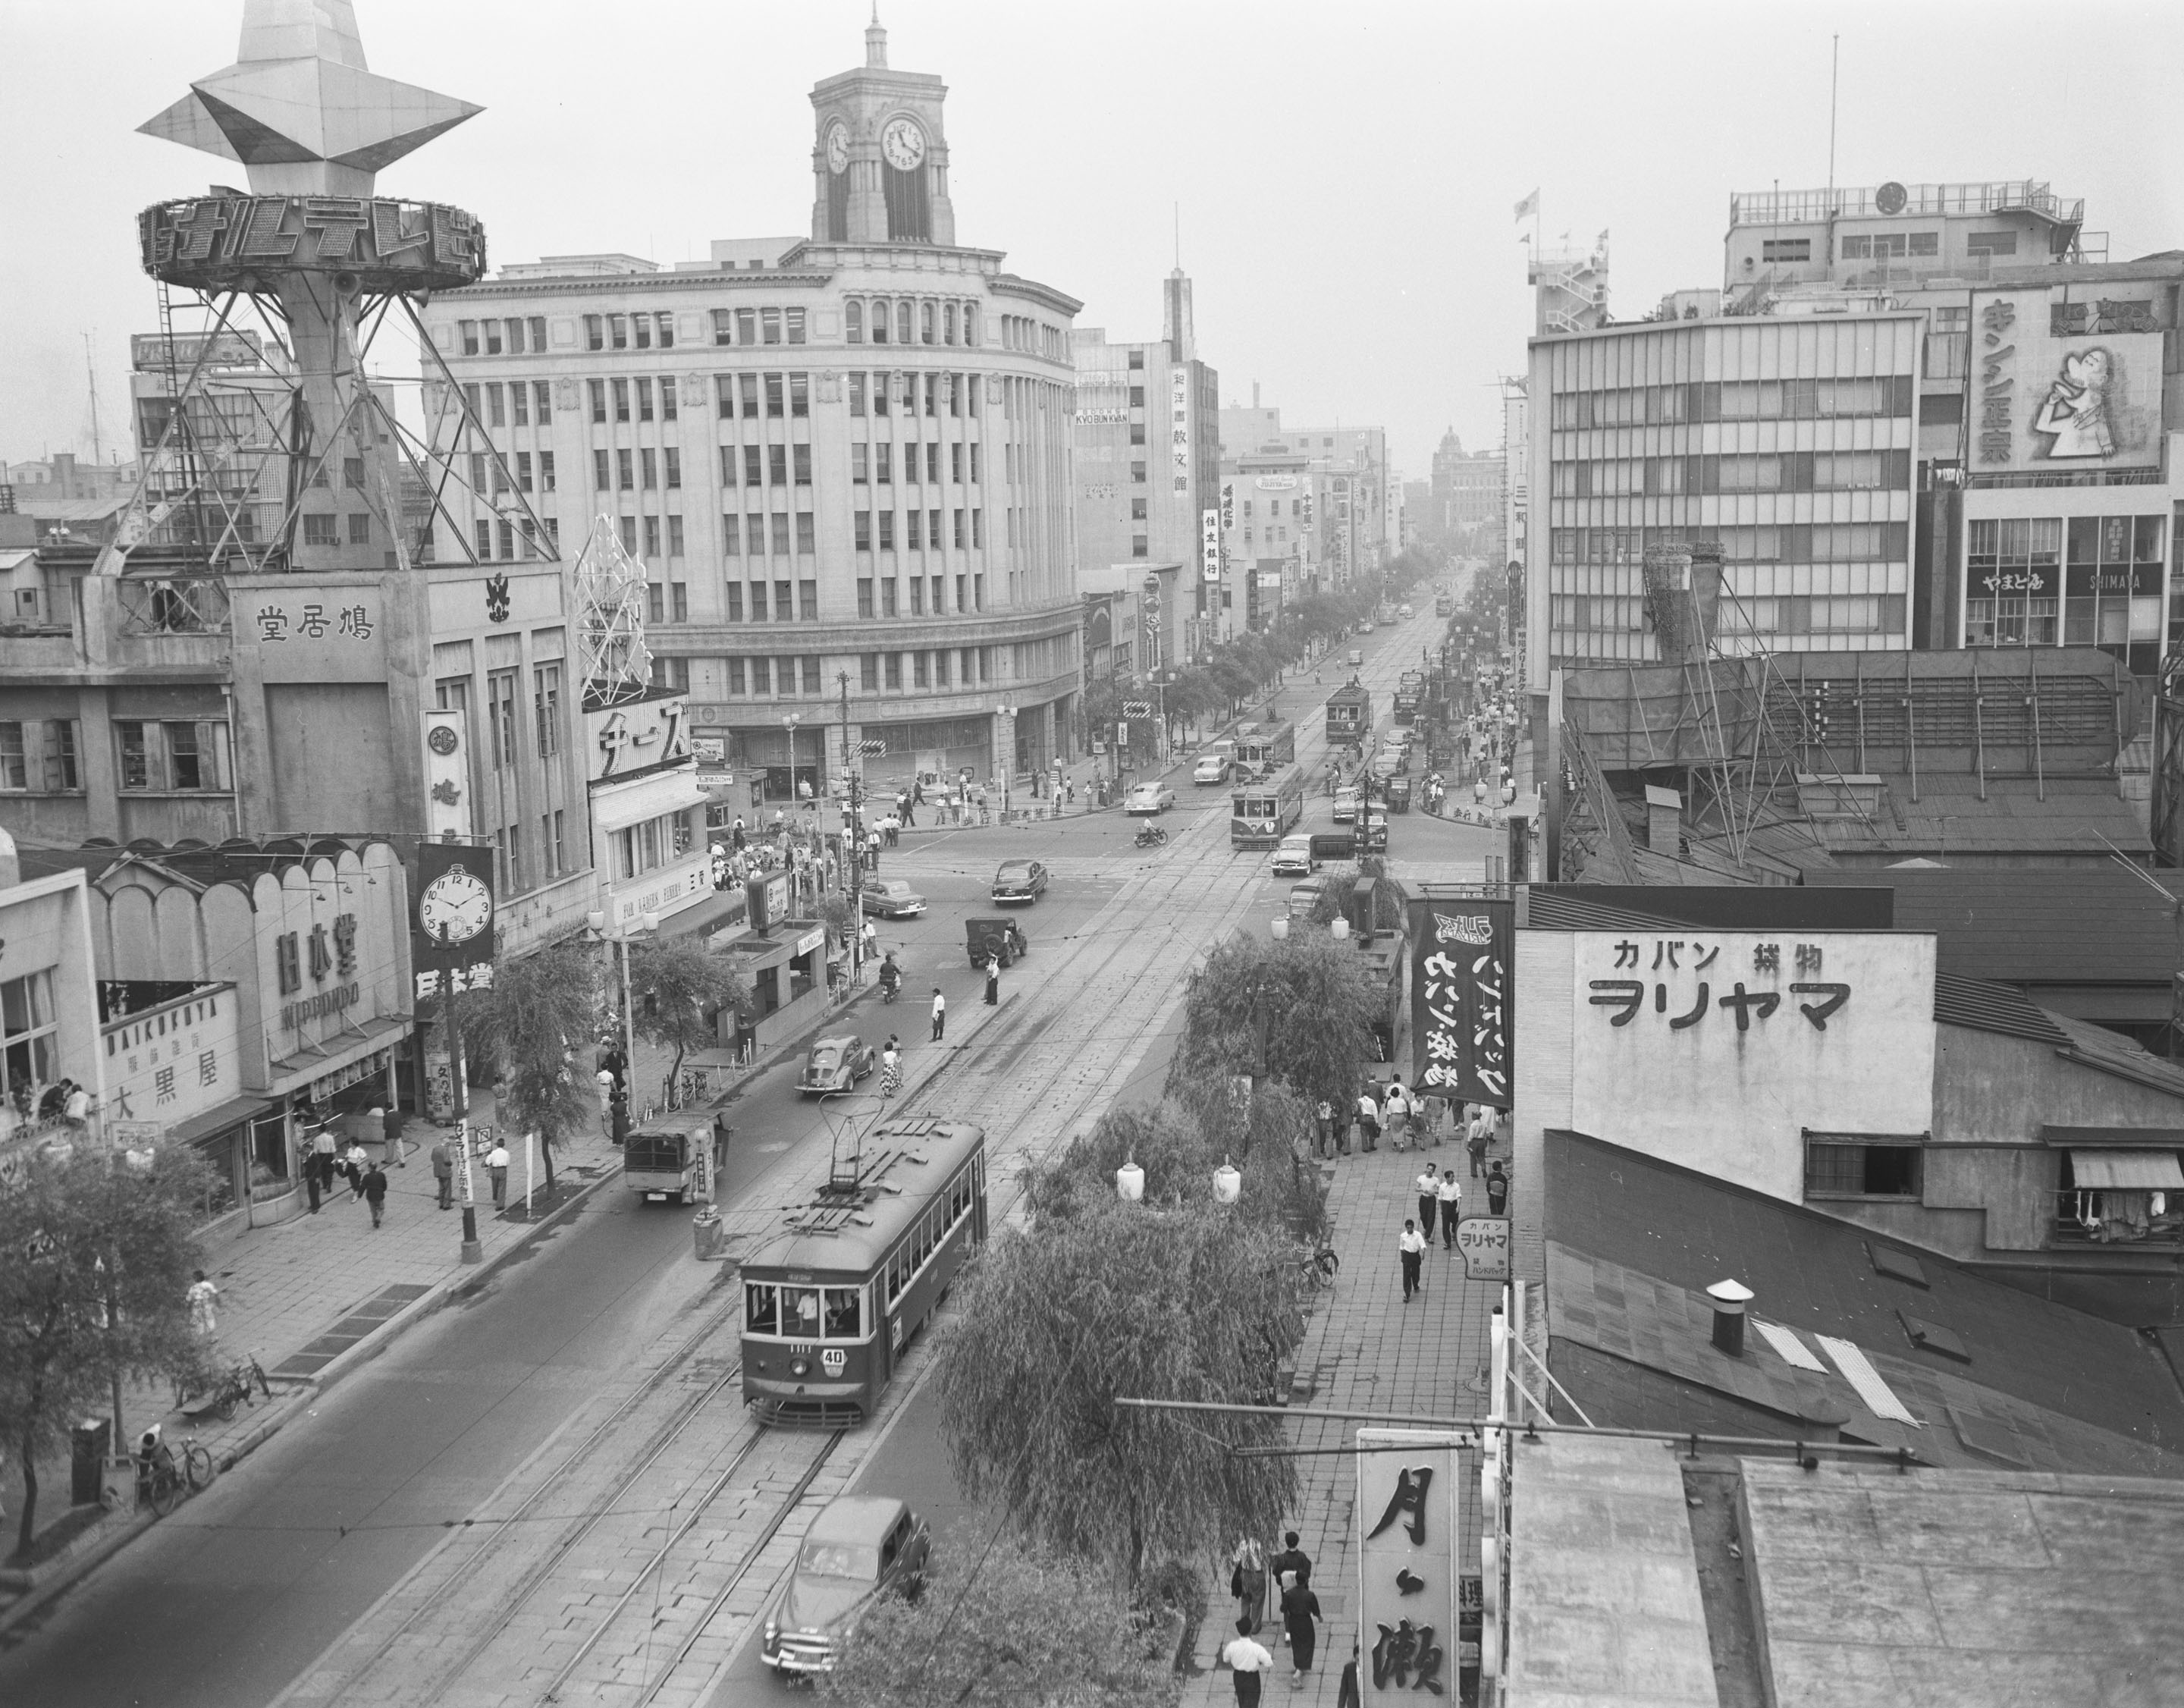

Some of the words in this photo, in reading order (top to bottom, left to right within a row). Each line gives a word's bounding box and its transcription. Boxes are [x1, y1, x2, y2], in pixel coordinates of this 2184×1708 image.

[1982, 299, 2016, 463] キンシ正宗
[1206, 516, 1217, 574] 住友銀行
[2090, 574, 2140, 589] SHIMAYA
[599, 702, 689, 777] チーズ
[437, 881, 445, 890] 11
[452, 875, 462, 884] 12
[467, 879, 473, 888] 1
[428, 890, 437, 900] 10
[478, 887, 485, 896] 2
[424, 905, 431, 915] 9
[482, 902, 488, 912] 3
[475, 915, 484, 925] 4
[466, 926, 473, 935] 5
[276, 913, 357, 996] 日本堂
[1614, 940, 1720, 972] カバン
[1589, 980, 1851, 1031] ヲリヤマ
[108, 997, 217, 1057] DAIKOKUYA
[112, 1050, 218, 1119] 大黒屋
[1470, 1222, 1502, 1232] カバン
[1461, 1233, 1508, 1249] ヲリヤマ
[824, 1351, 843, 1364] 40
